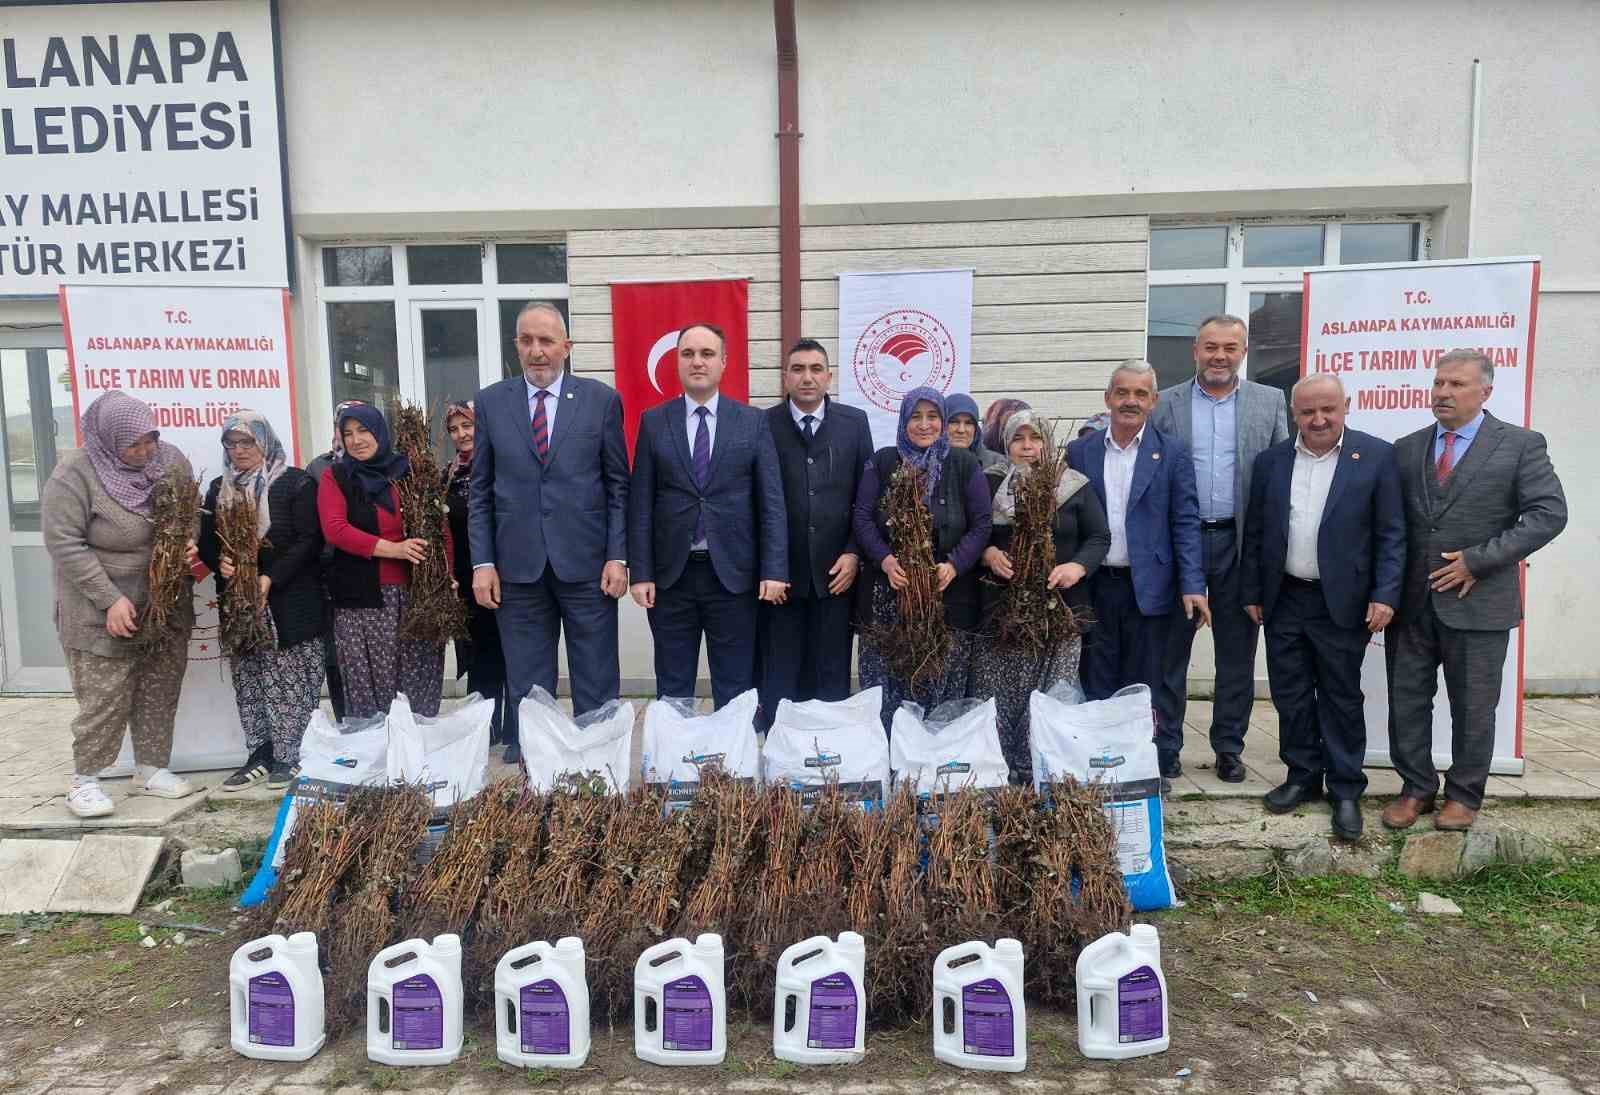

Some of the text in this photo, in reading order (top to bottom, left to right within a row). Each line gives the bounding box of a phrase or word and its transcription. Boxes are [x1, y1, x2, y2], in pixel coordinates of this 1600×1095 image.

[3, 31, 249, 89] LANAPA
[1404, 290, 1431, 305] T.C.
[165, 310, 192, 324] T.C.
[1321, 312, 1516, 336] ASLANAPA KAYMAKAMLIĞI
[87, 335, 274, 351] ASLANAPA KAYMAKAMLIĞI
[1316, 349, 1353, 376] İLÇE
[1359, 350, 1417, 370] TARIM
[1449, 347, 1518, 368] MAN
[85, 364, 281, 391] İLÇE TARIM VE ORMAN
